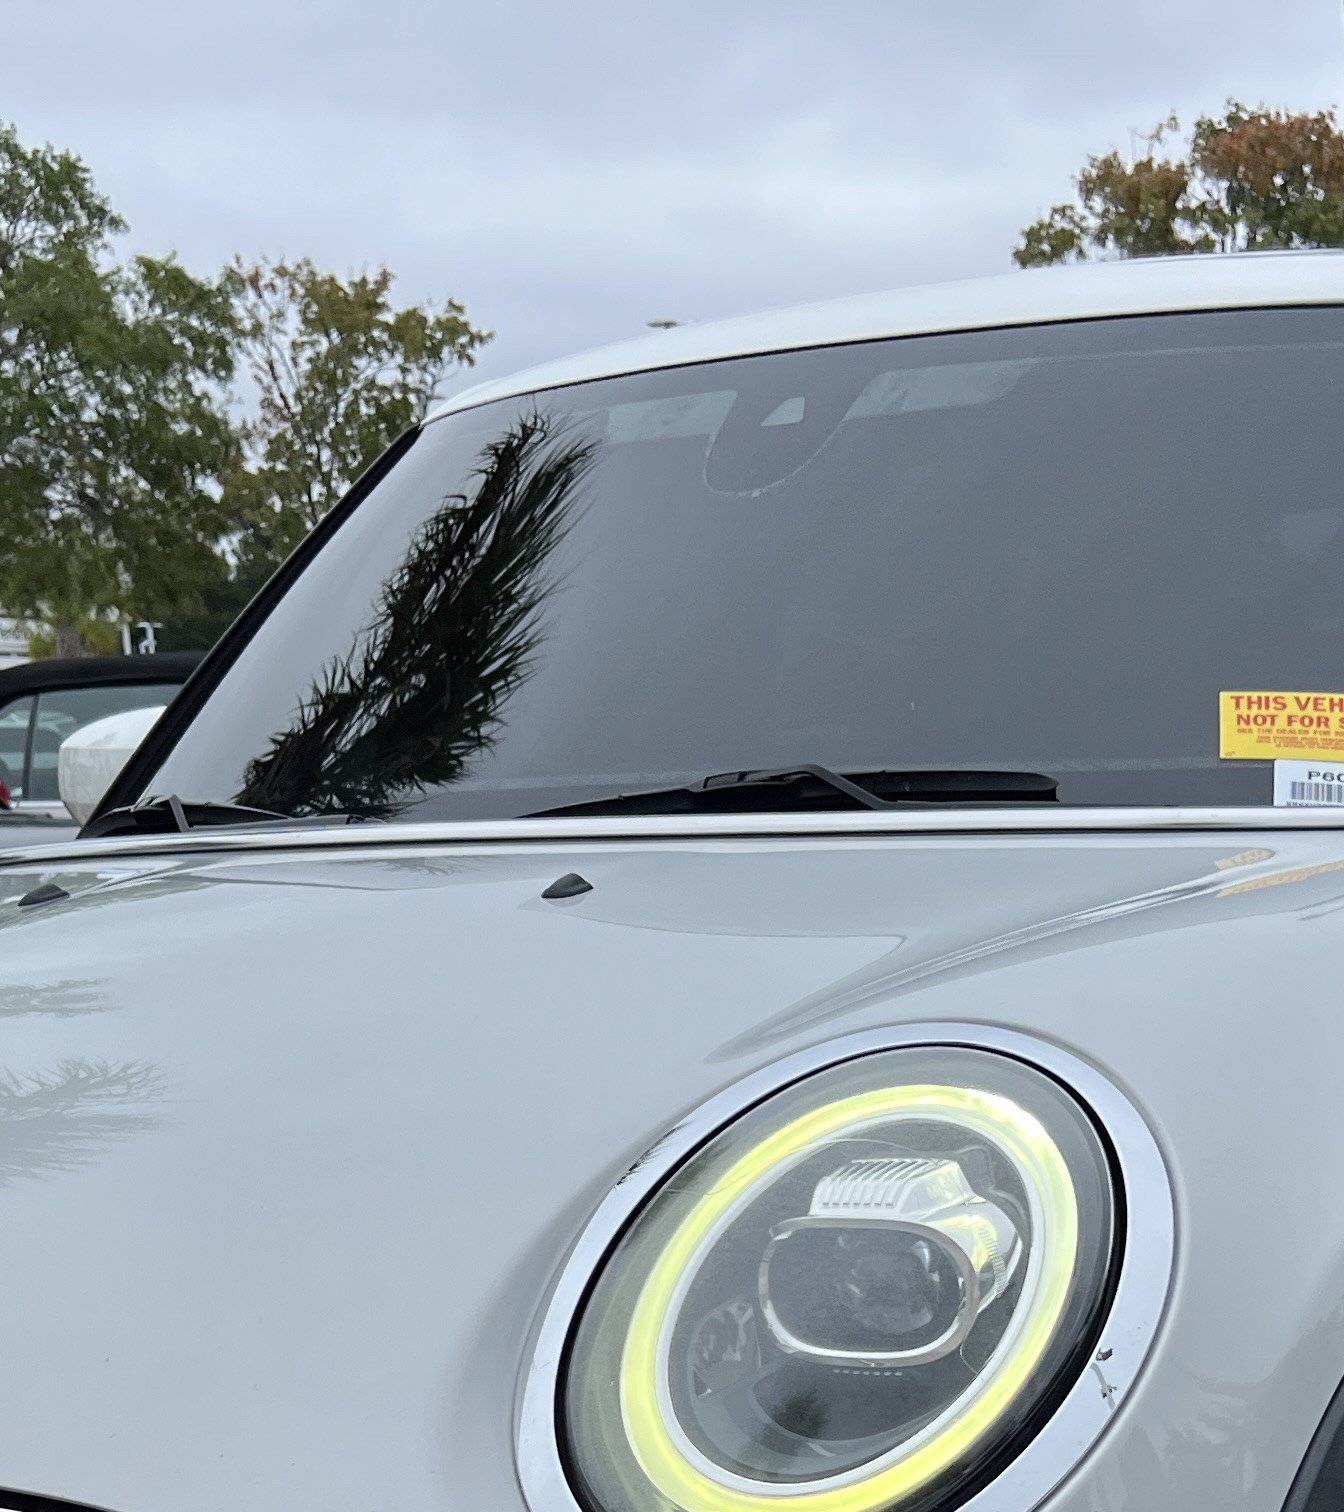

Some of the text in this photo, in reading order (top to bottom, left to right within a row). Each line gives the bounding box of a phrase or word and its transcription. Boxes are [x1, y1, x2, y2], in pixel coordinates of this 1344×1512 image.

[1230, 695, 1288, 711] THIS
[1236, 713, 1279, 727] NOT
[1287, 714, 1330, 729] FOR
